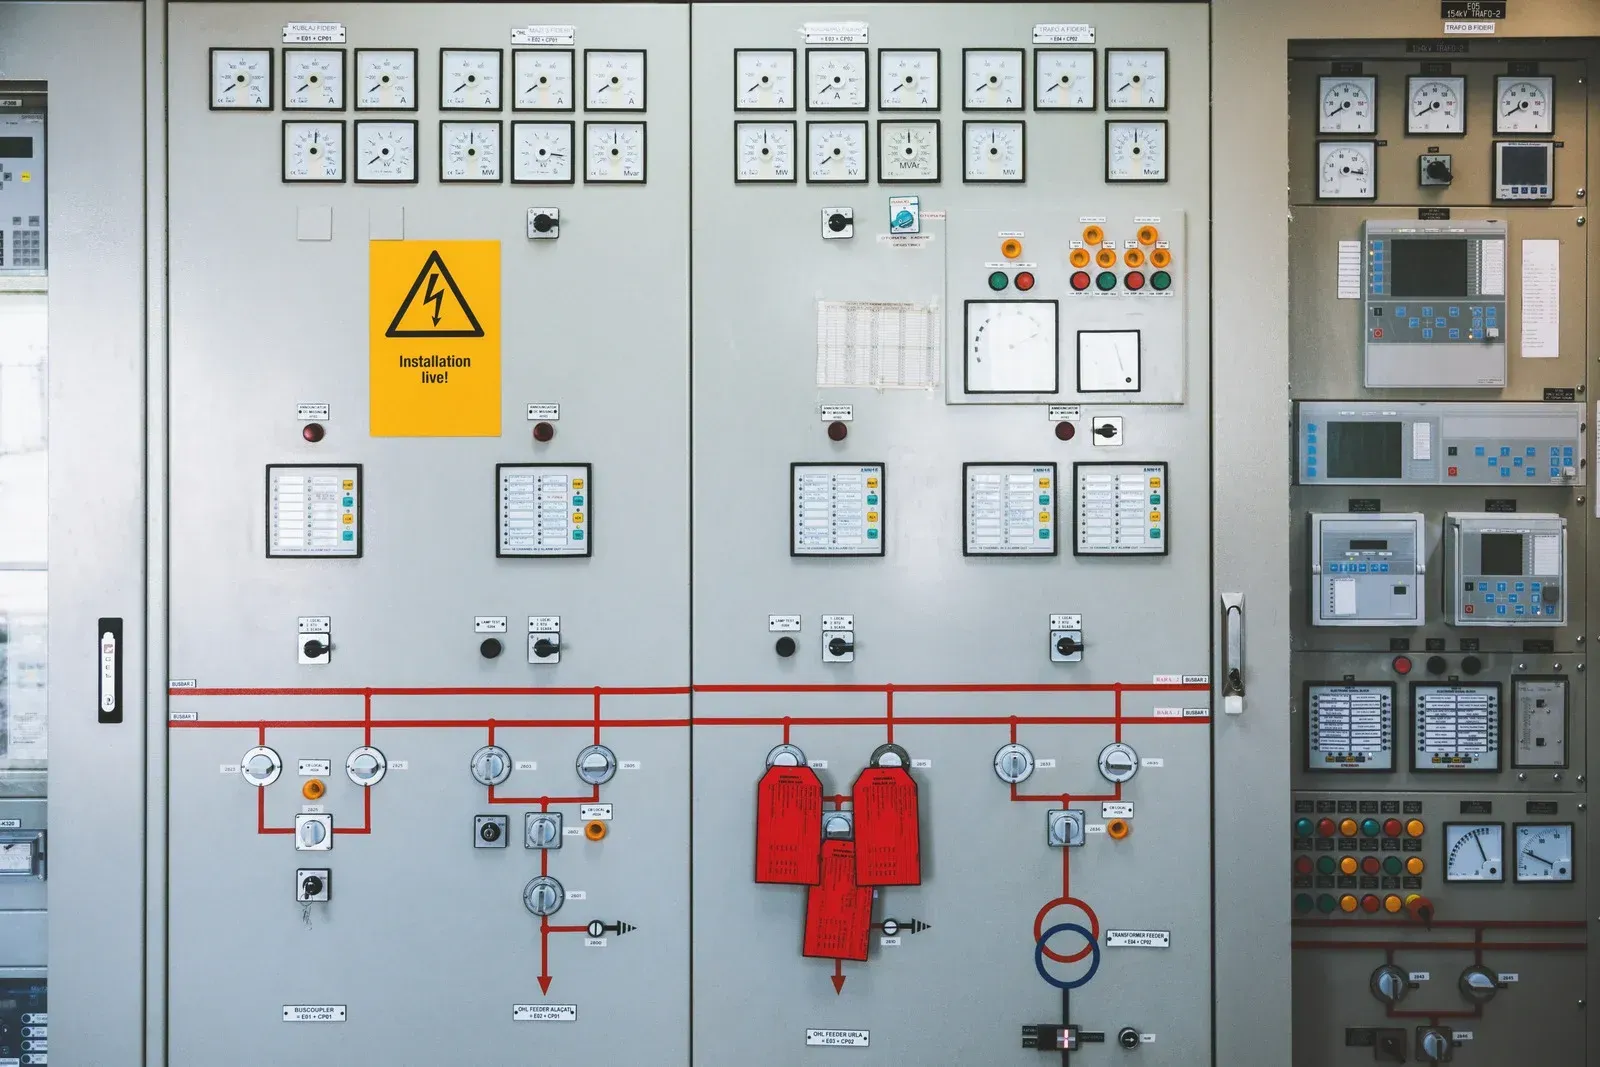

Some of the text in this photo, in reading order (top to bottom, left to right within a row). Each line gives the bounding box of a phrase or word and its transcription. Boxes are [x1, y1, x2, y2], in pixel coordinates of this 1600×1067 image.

[1467, 3, 1480, 11] E05
[400, 355, 471, 368] Installation
[422, 372, 448, 384] live!
